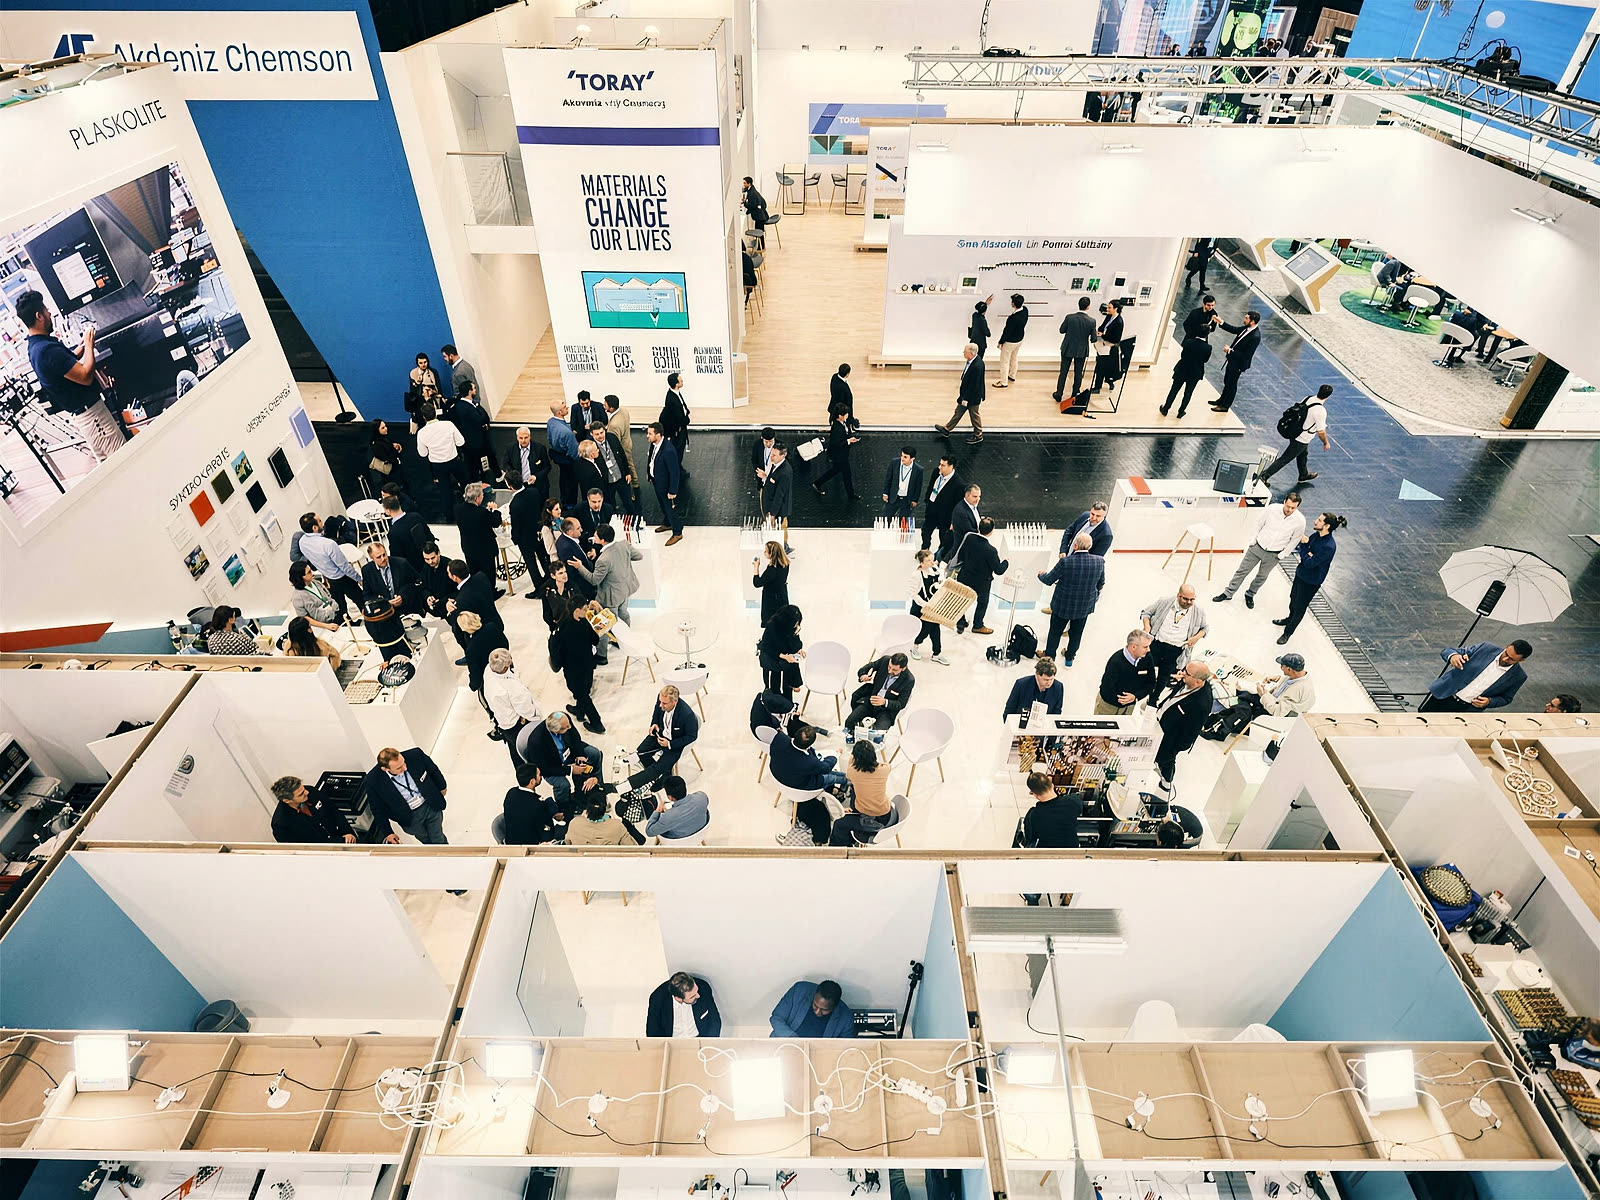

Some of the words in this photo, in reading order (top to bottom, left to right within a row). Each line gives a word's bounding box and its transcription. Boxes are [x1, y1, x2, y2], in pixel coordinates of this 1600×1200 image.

[225, 43, 353, 72] Chemson
[68, 99, 167, 150] PLASKOLITE
[838, 116, 860, 124] TORA
[580, 174, 667, 197] MATERIALS
[585, 198, 670, 228] CHANGE
[590, 229, 623, 251] OUR
[626, 229, 672, 252] LIVES
